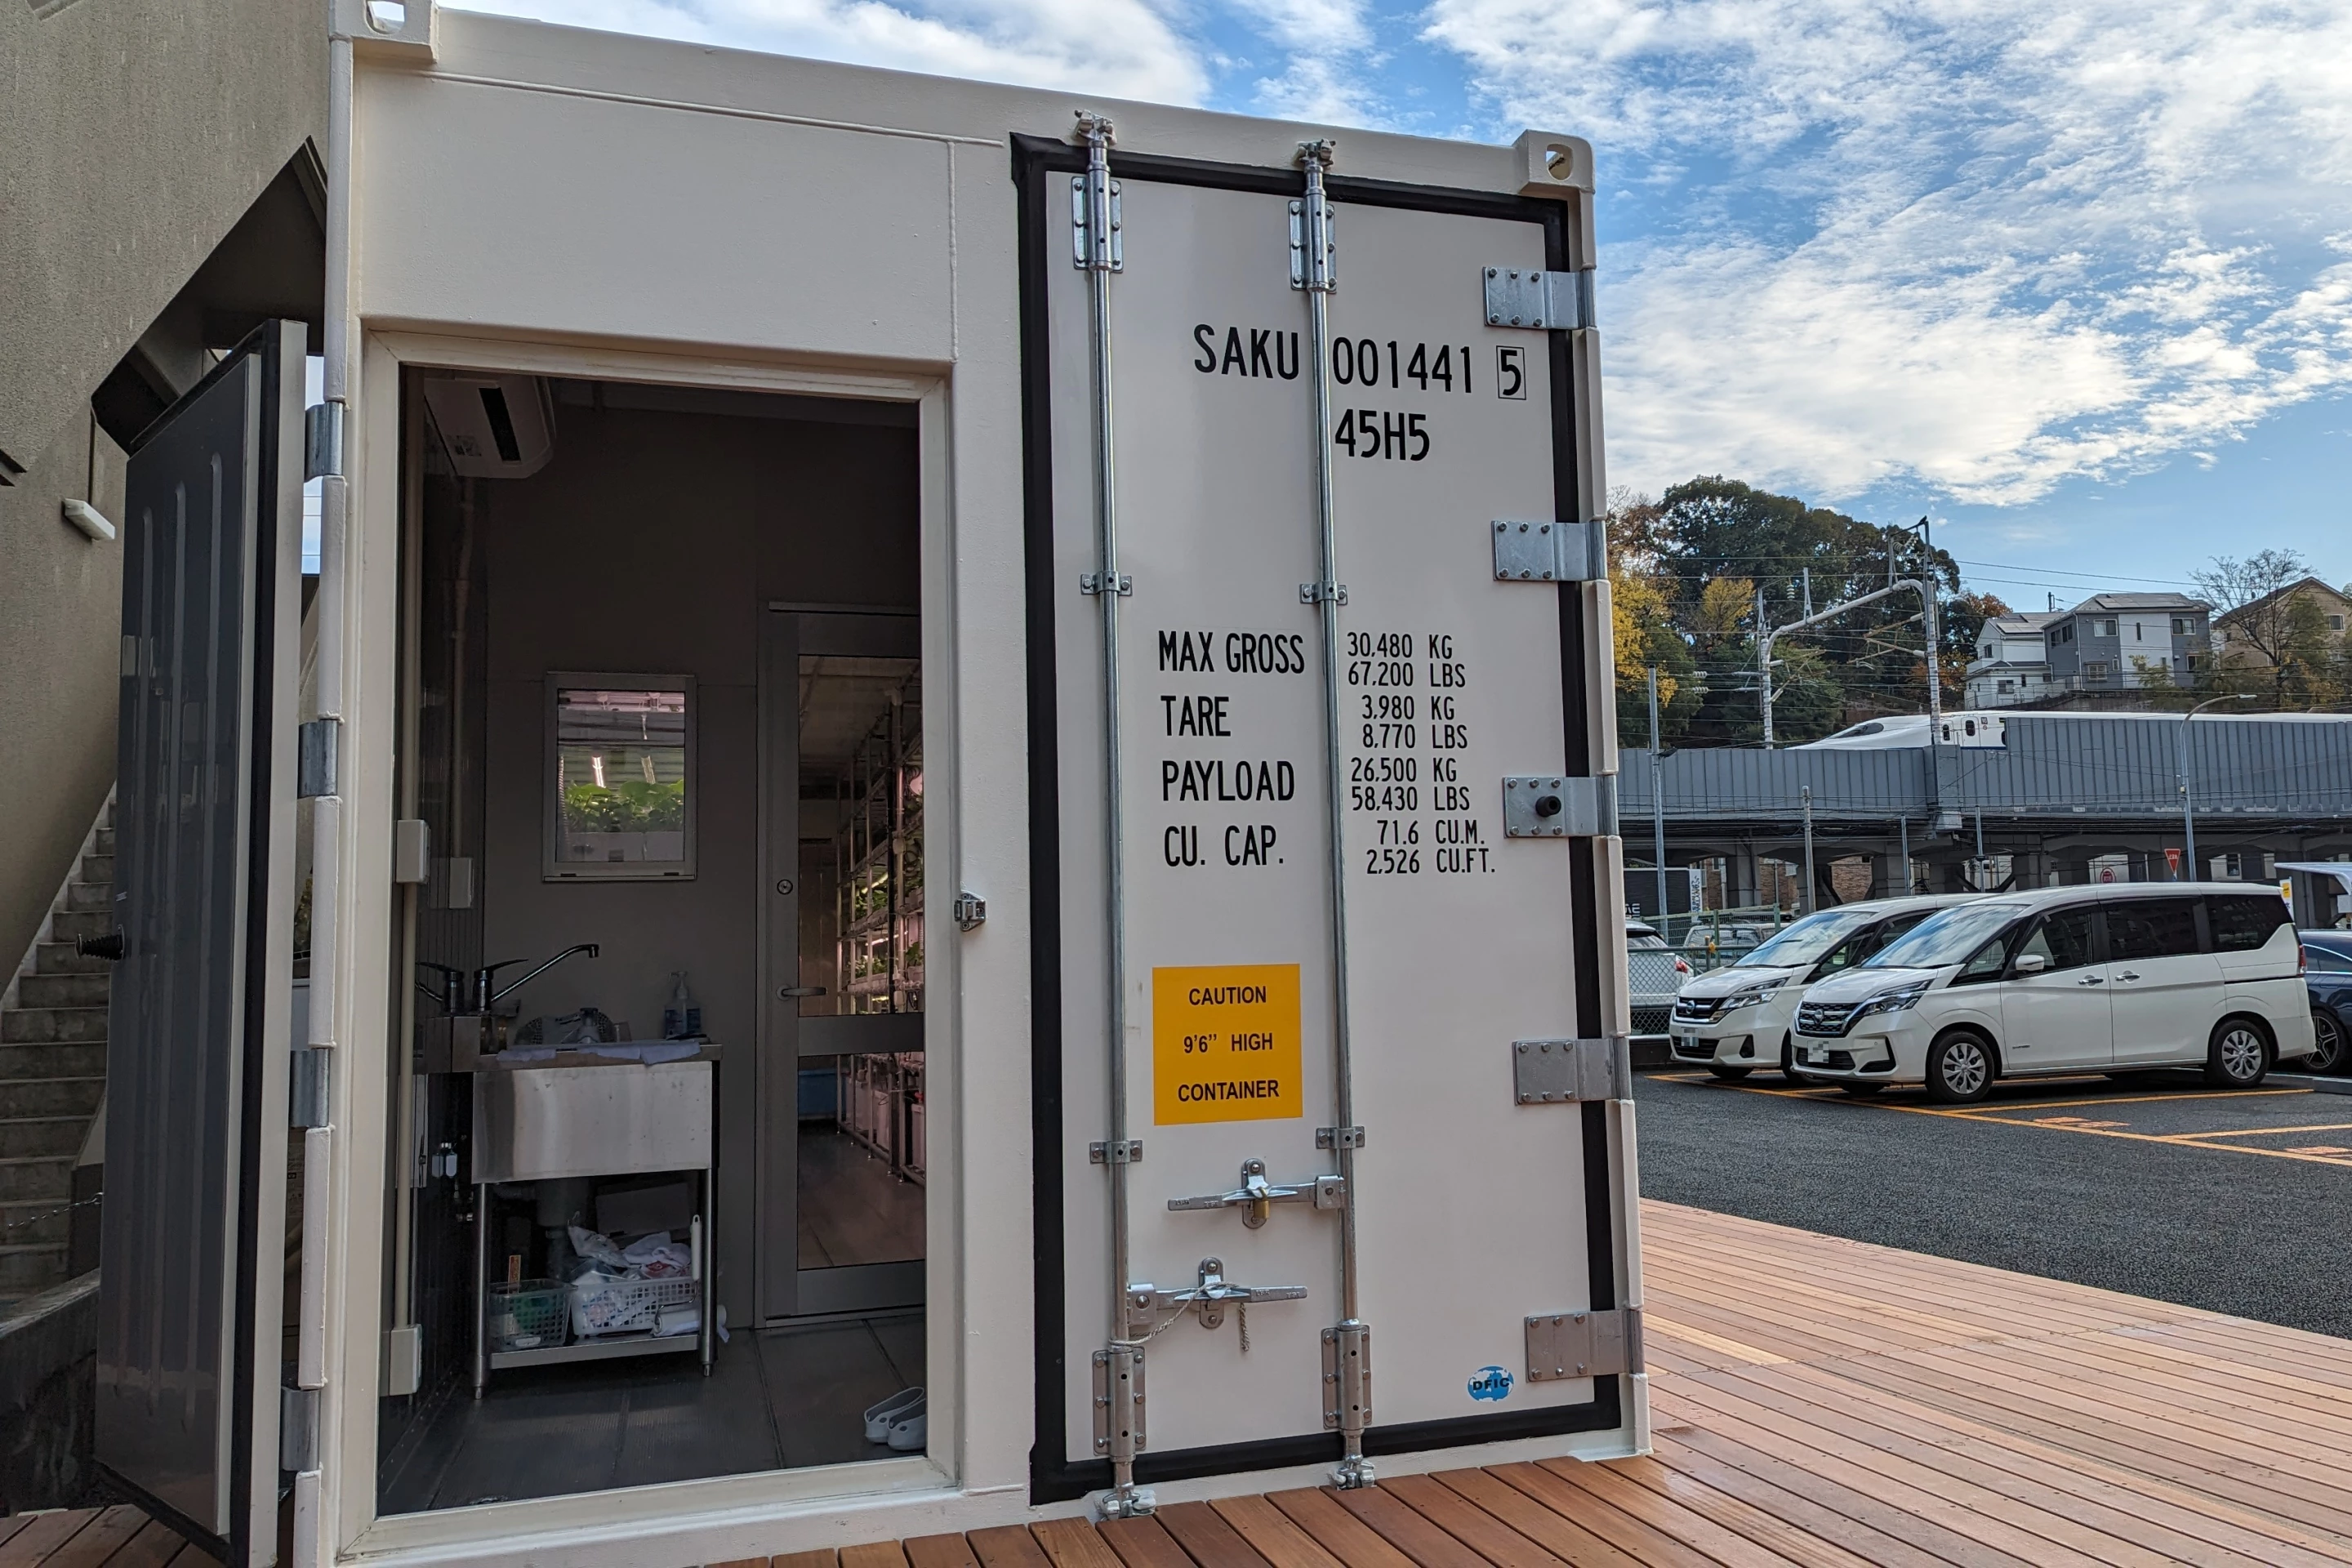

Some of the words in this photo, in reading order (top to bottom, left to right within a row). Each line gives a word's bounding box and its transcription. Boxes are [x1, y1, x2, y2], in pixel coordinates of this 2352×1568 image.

[1193, 323, 1299, 381] SAKU
[1332, 336, 1472, 394] 001441
[1500, 350, 1522, 396] 5
[1334, 408, 1430, 461] 45H5
[1158, 630, 1215, 673] MAX
[1225, 632, 1305, 675] GROSS
[1347, 631, 1413, 658] 30,480
[1428, 634, 1453, 660] KG
[1348, 661, 1414, 687] 67,200
[1429, 662, 1466, 688] LBS
[1160, 695, 1232, 737] TARE
[1361, 694, 1415, 720] 3,980
[1430, 695, 1454, 721] KG
[1362, 723, 1416, 749] 8,770
[1432, 724, 1468, 750] LBS
[1161, 760, 1295, 802] PAYLOAD
[1350, 756, 1417, 782] 26,500
[1432, 757, 1457, 782] KG
[1352, 786, 1418, 812] 58,430
[1433, 786, 1470, 811] LBS
[1164, 825, 1205, 867] CU.
[1224, 824, 1285, 866] CAP.
[1376, 819, 1419, 845] 71.6
[1435, 819, 1485, 845] CU.M.
[1366, 849, 1420, 875] 2,526
[1436, 848, 1495, 874] CU.FT.
[1188, 985, 1267, 1006] CAUTION
[1231, 1032, 1273, 1052] HIGH
[1178, 1079, 1280, 1102] CONTAINER
[1472, 1378, 1510, 1391] DFIC
